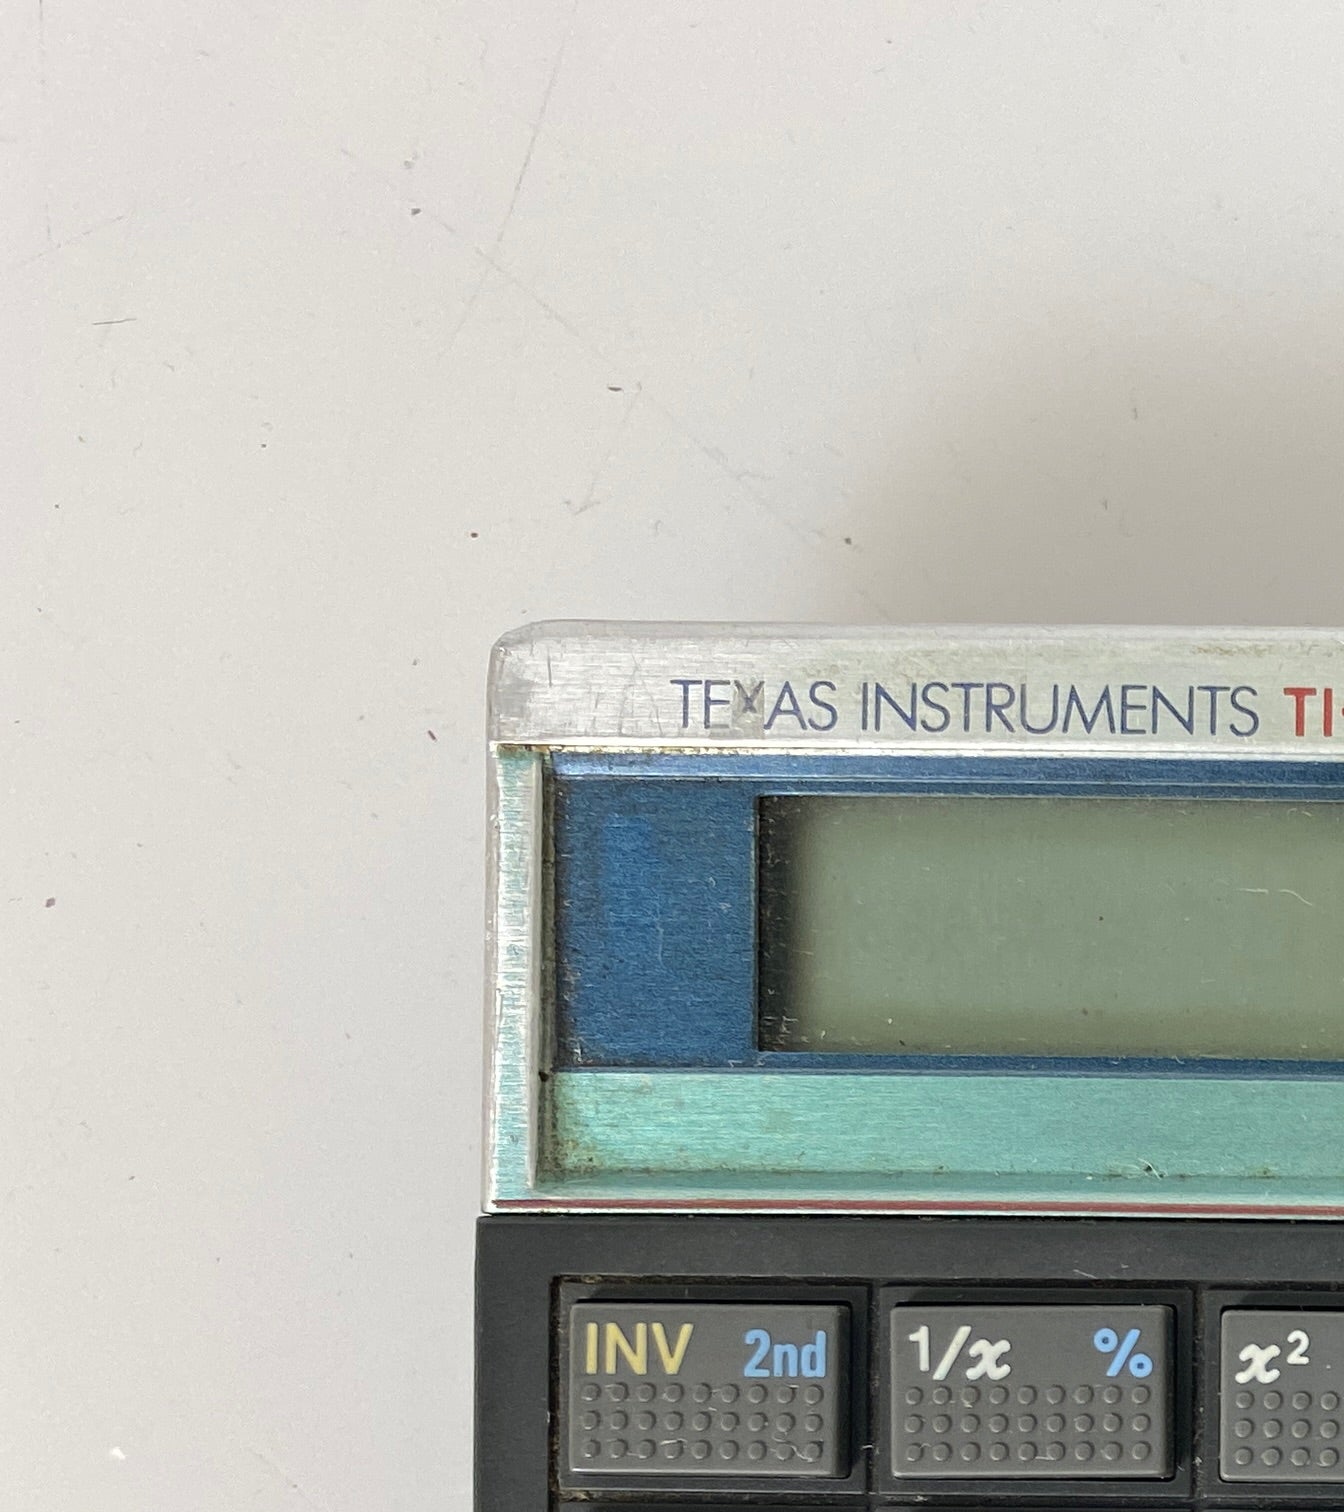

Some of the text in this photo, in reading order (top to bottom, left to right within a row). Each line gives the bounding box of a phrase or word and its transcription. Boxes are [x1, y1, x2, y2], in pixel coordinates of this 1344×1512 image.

[670, 680, 837, 731] TEXAS
[861, 682, 1259, 737] INSTRUMENTS
[586, 1323, 828, 1377] INV 2nd
[909, 1326, 1152, 1380] 1/x %
